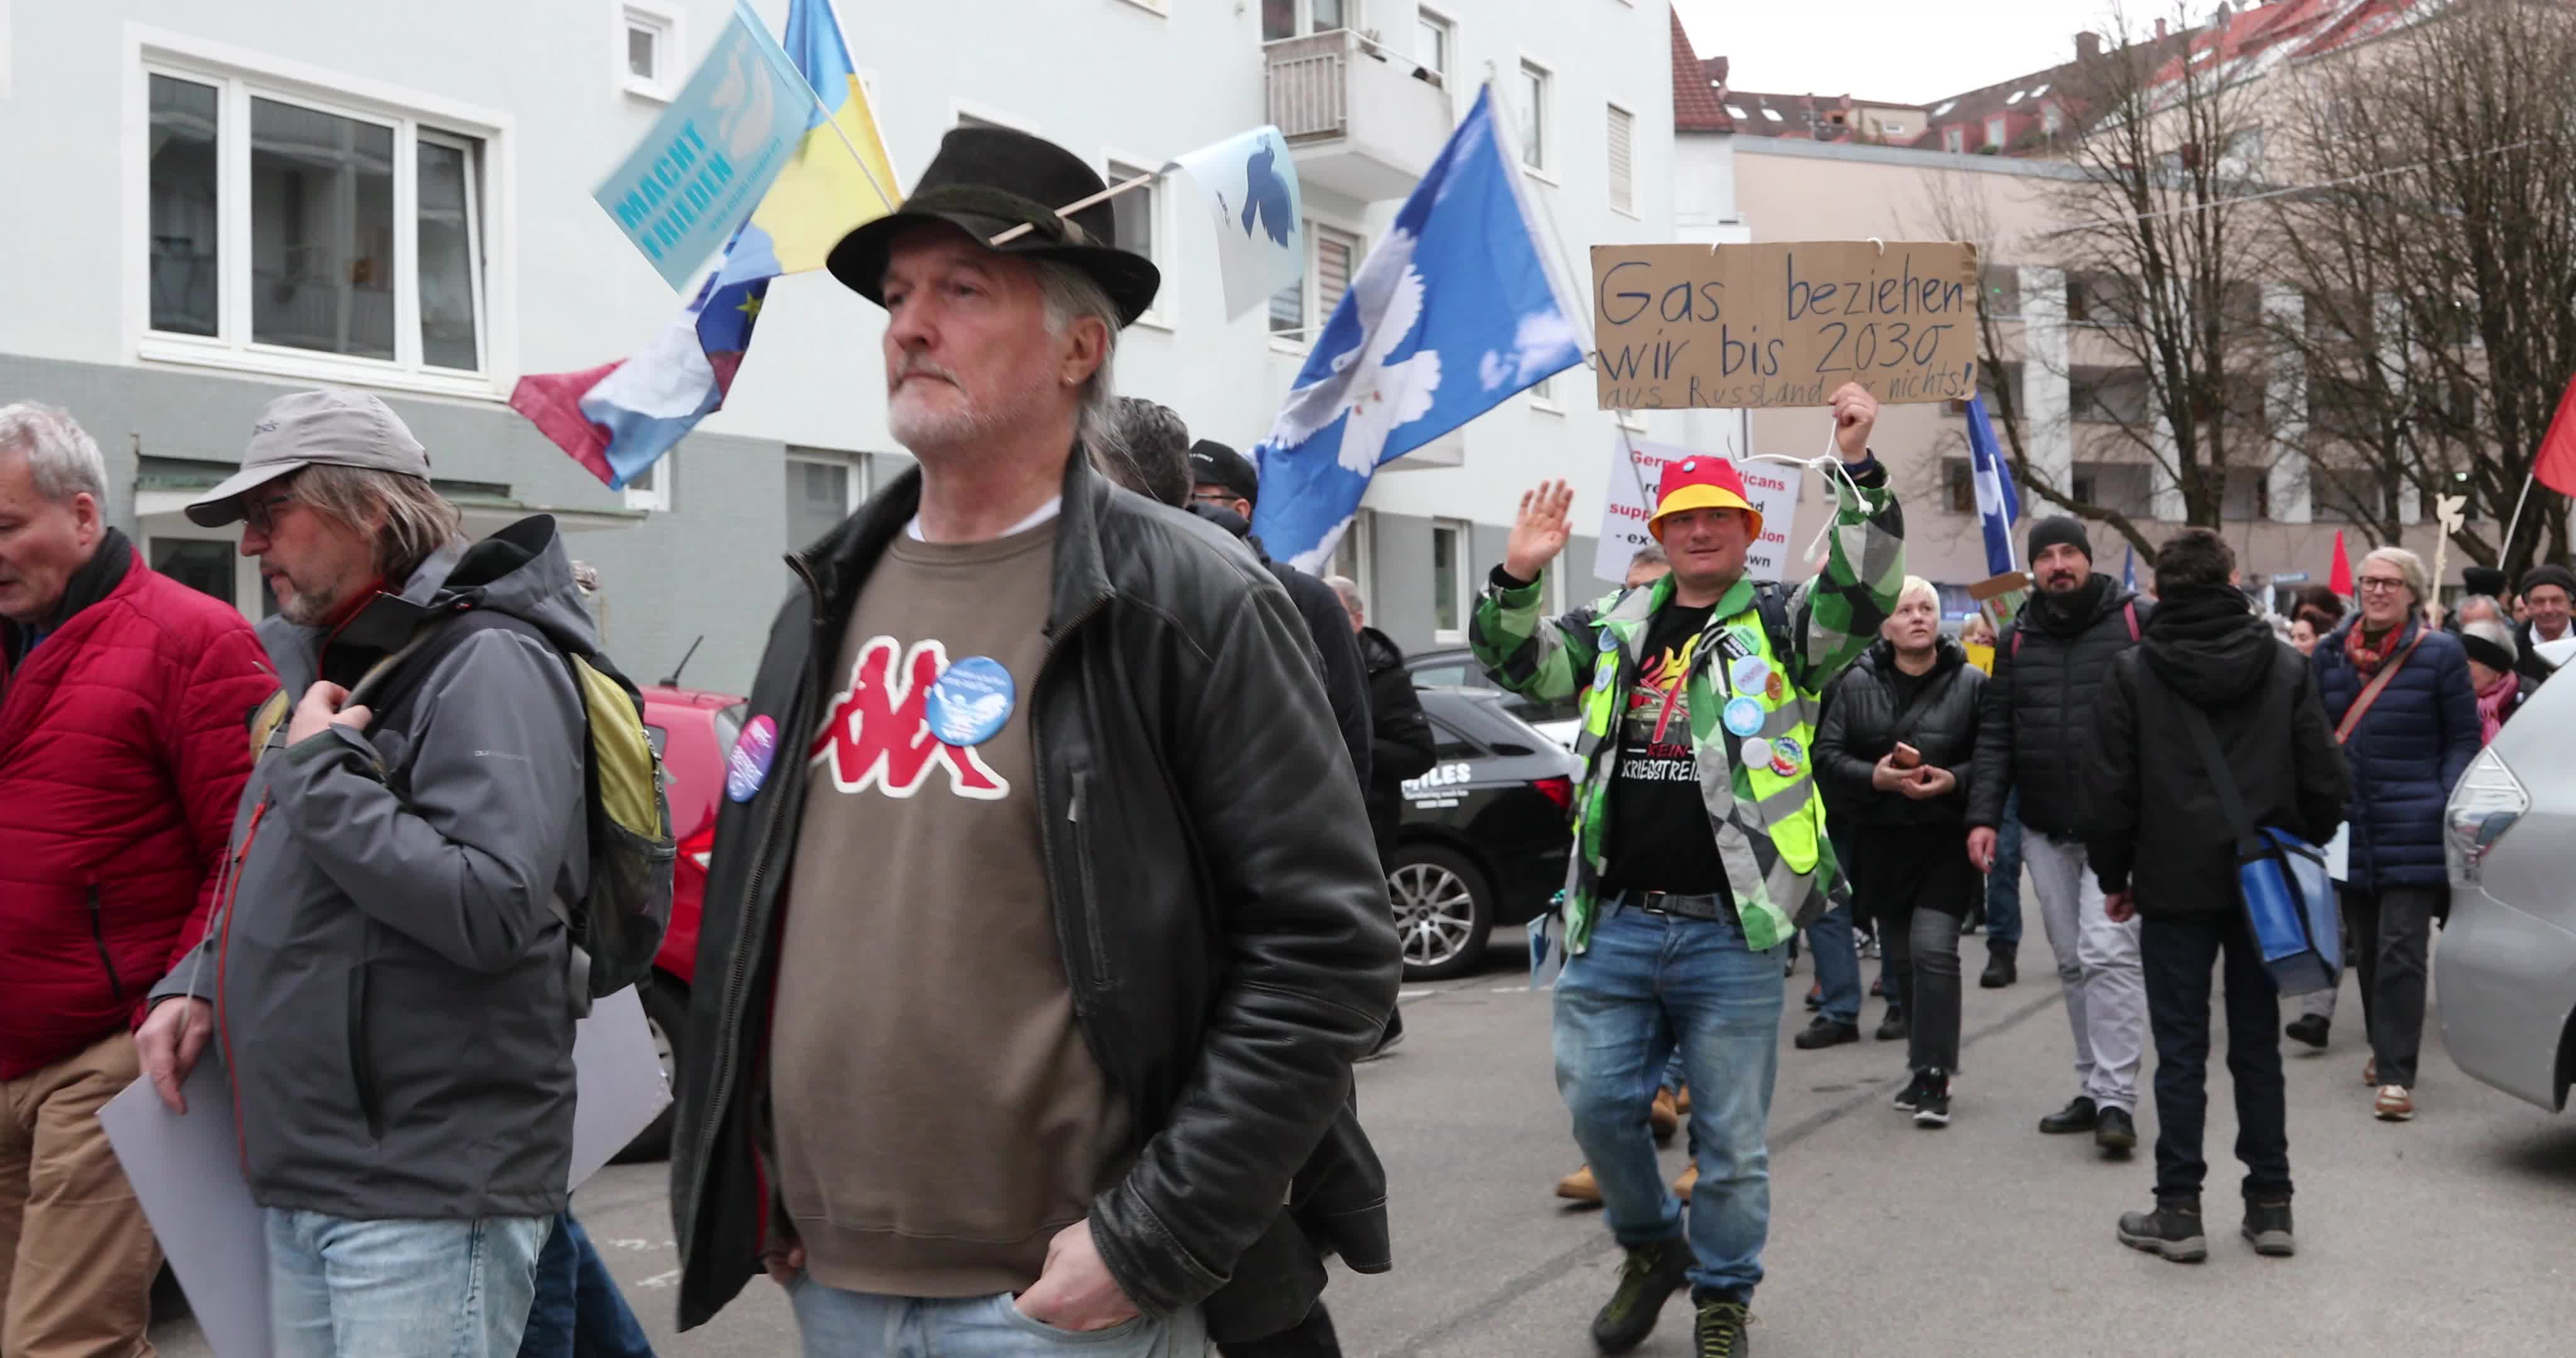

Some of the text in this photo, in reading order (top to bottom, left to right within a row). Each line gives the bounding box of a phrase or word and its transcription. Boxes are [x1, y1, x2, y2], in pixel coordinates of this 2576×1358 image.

[614, 119, 705, 230] MACHT
[1601, 251, 1963, 325] Gas beziehen
[1599, 321, 1955, 381] wir bis 2030
[1605, 386, 1664, 409] aus
[1889, 360, 1973, 400] nichts!
[1646, 744, 1689, 758] KEIN
